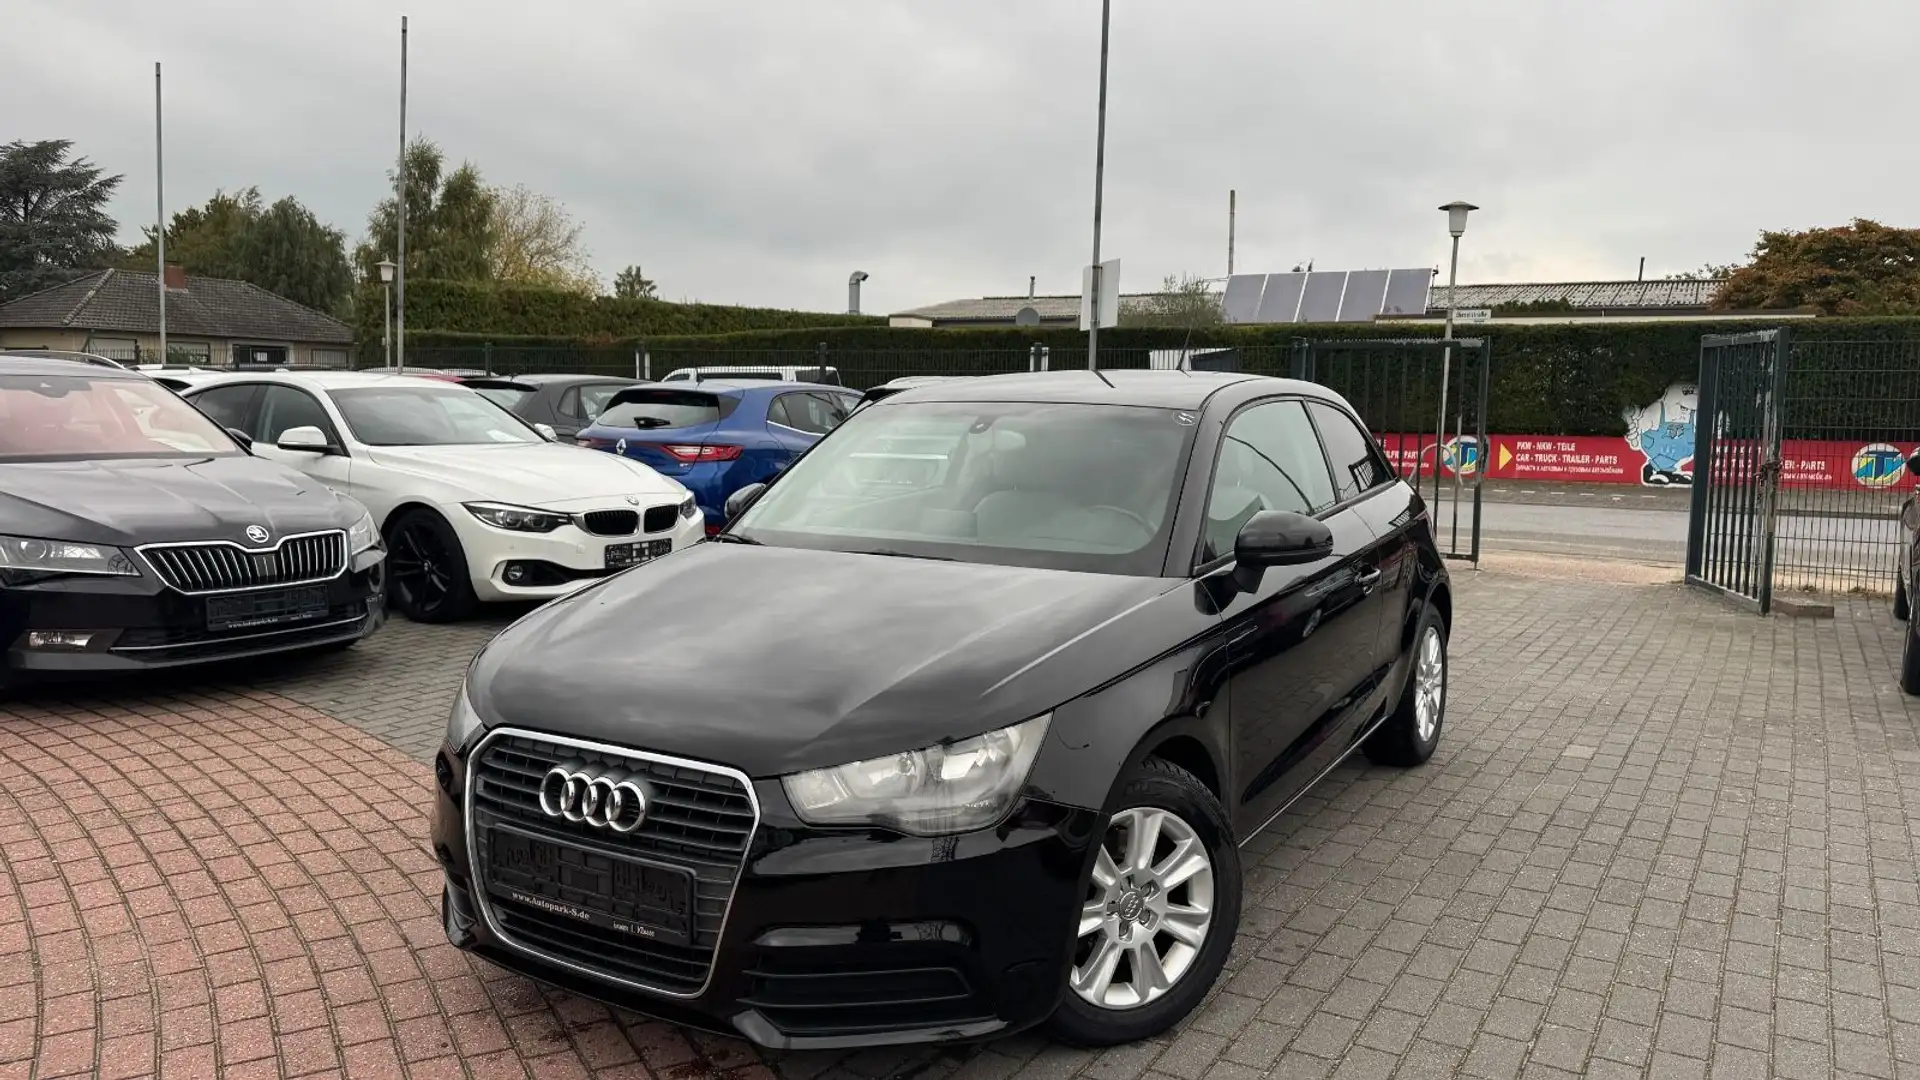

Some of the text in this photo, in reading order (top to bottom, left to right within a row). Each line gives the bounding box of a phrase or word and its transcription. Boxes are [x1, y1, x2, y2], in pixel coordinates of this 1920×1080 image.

[1516, 441, 1533, 450] PKW
[1557, 442, 1576, 452] TEILE
[1515, 453, 1530, 462] CAR
[1534, 453, 1557, 463] TRUCK
[1562, 454, 1590, 464] TRAILER
[1594, 455, 1618, 465] PARTS
[1800, 460, 1826, 471] PARTS
[511, 891, 591, 922] www.Autopark-S.de
